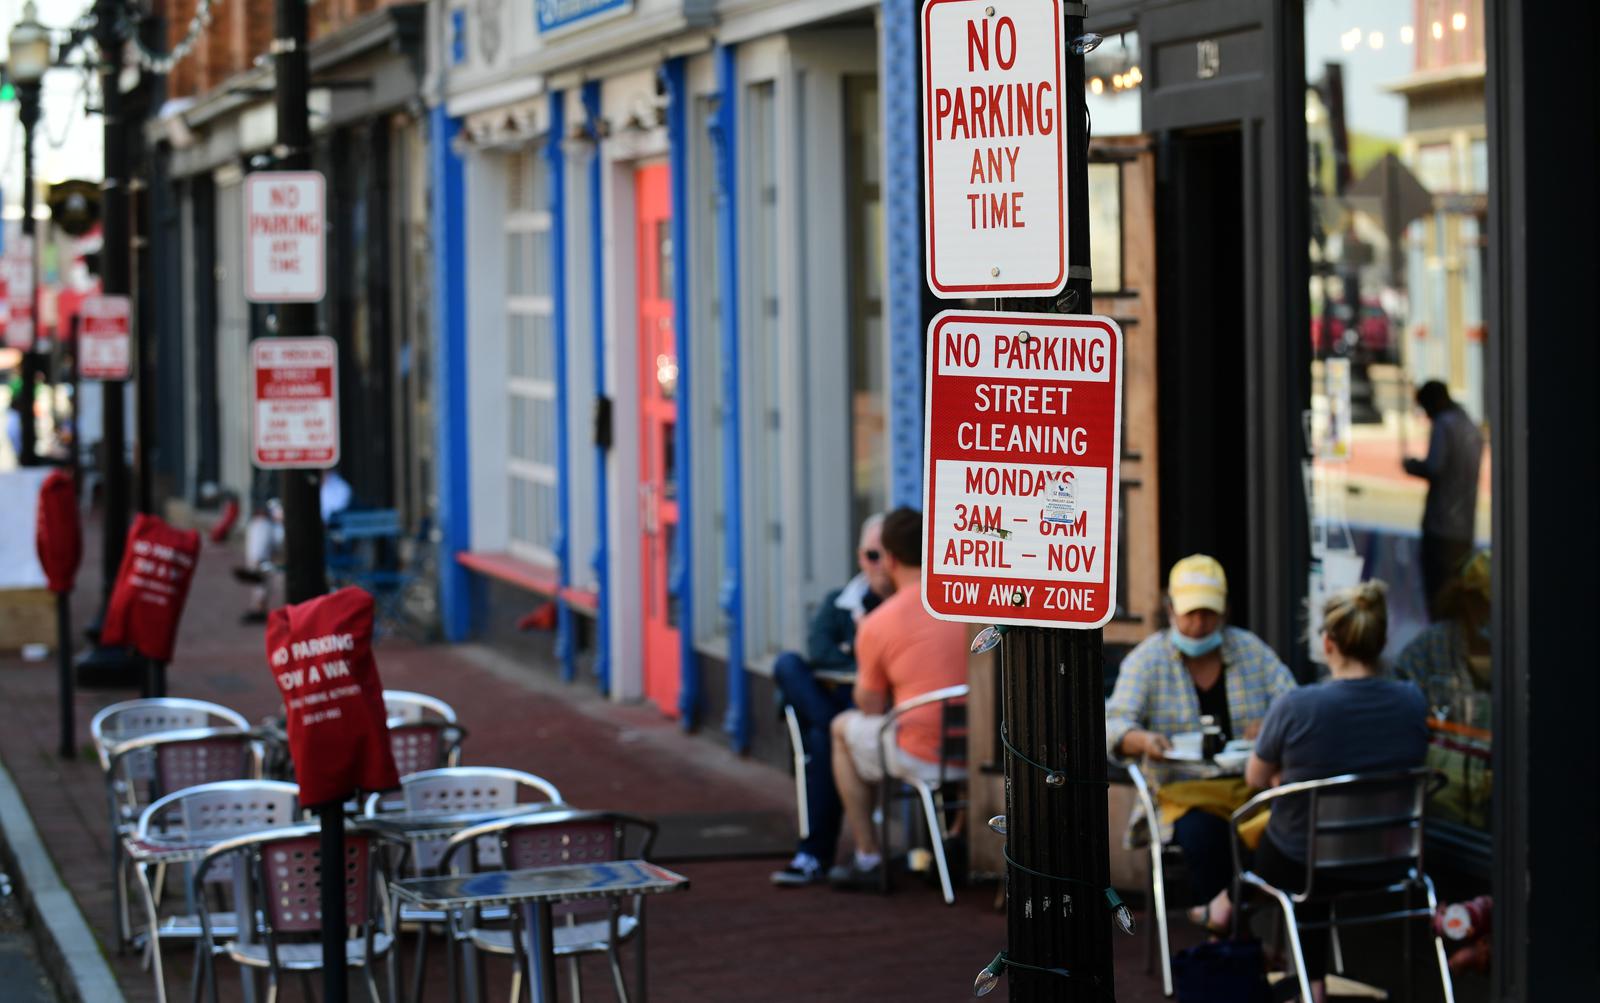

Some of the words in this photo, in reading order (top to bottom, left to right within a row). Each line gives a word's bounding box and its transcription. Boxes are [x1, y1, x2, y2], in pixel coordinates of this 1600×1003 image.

[967, 16, 1017, 72] NO
[935, 80, 1053, 141] PARKING
[969, 146, 1020, 184] ANY
[269, 185, 300, 208] NO
[966, 191, 1025, 229] TIME
[945, 333, 981, 368] NO
[994, 335, 1105, 374] PARKING
[974, 383, 1073, 415] STREET
[957, 421, 1087, 456] CLEANING
[953, 503, 1002, 533] 3AM
[943, 538, 1012, 569] APRIL
[1047, 543, 1096, 573] NOV
[942, 581, 980, 605] TOW
[1043, 587, 1095, 611] ZONE
[291, 632, 354, 661] PARKING
[322, 658, 351, 680] WA
